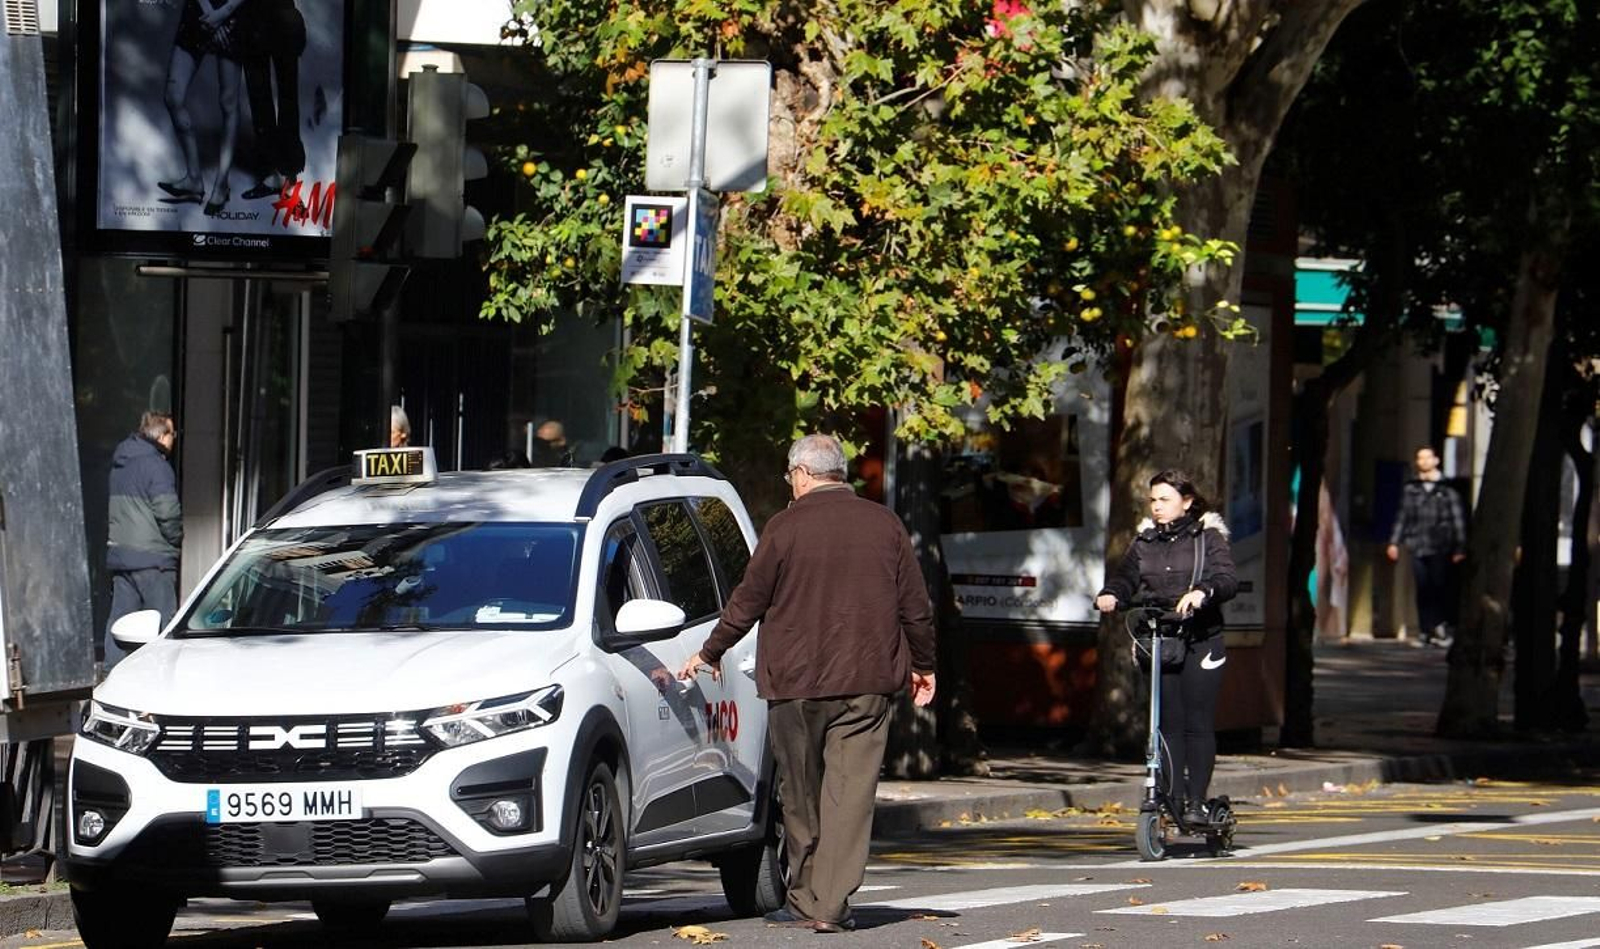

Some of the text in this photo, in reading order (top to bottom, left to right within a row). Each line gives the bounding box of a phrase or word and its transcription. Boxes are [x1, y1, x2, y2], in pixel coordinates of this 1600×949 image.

[272, 181, 335, 229] H&M
[207, 236, 269, 248] Clear Channel
[367, 453, 408, 476] TAXI
[227, 792, 293, 818] 9569
[303, 790, 352, 816] MMH
